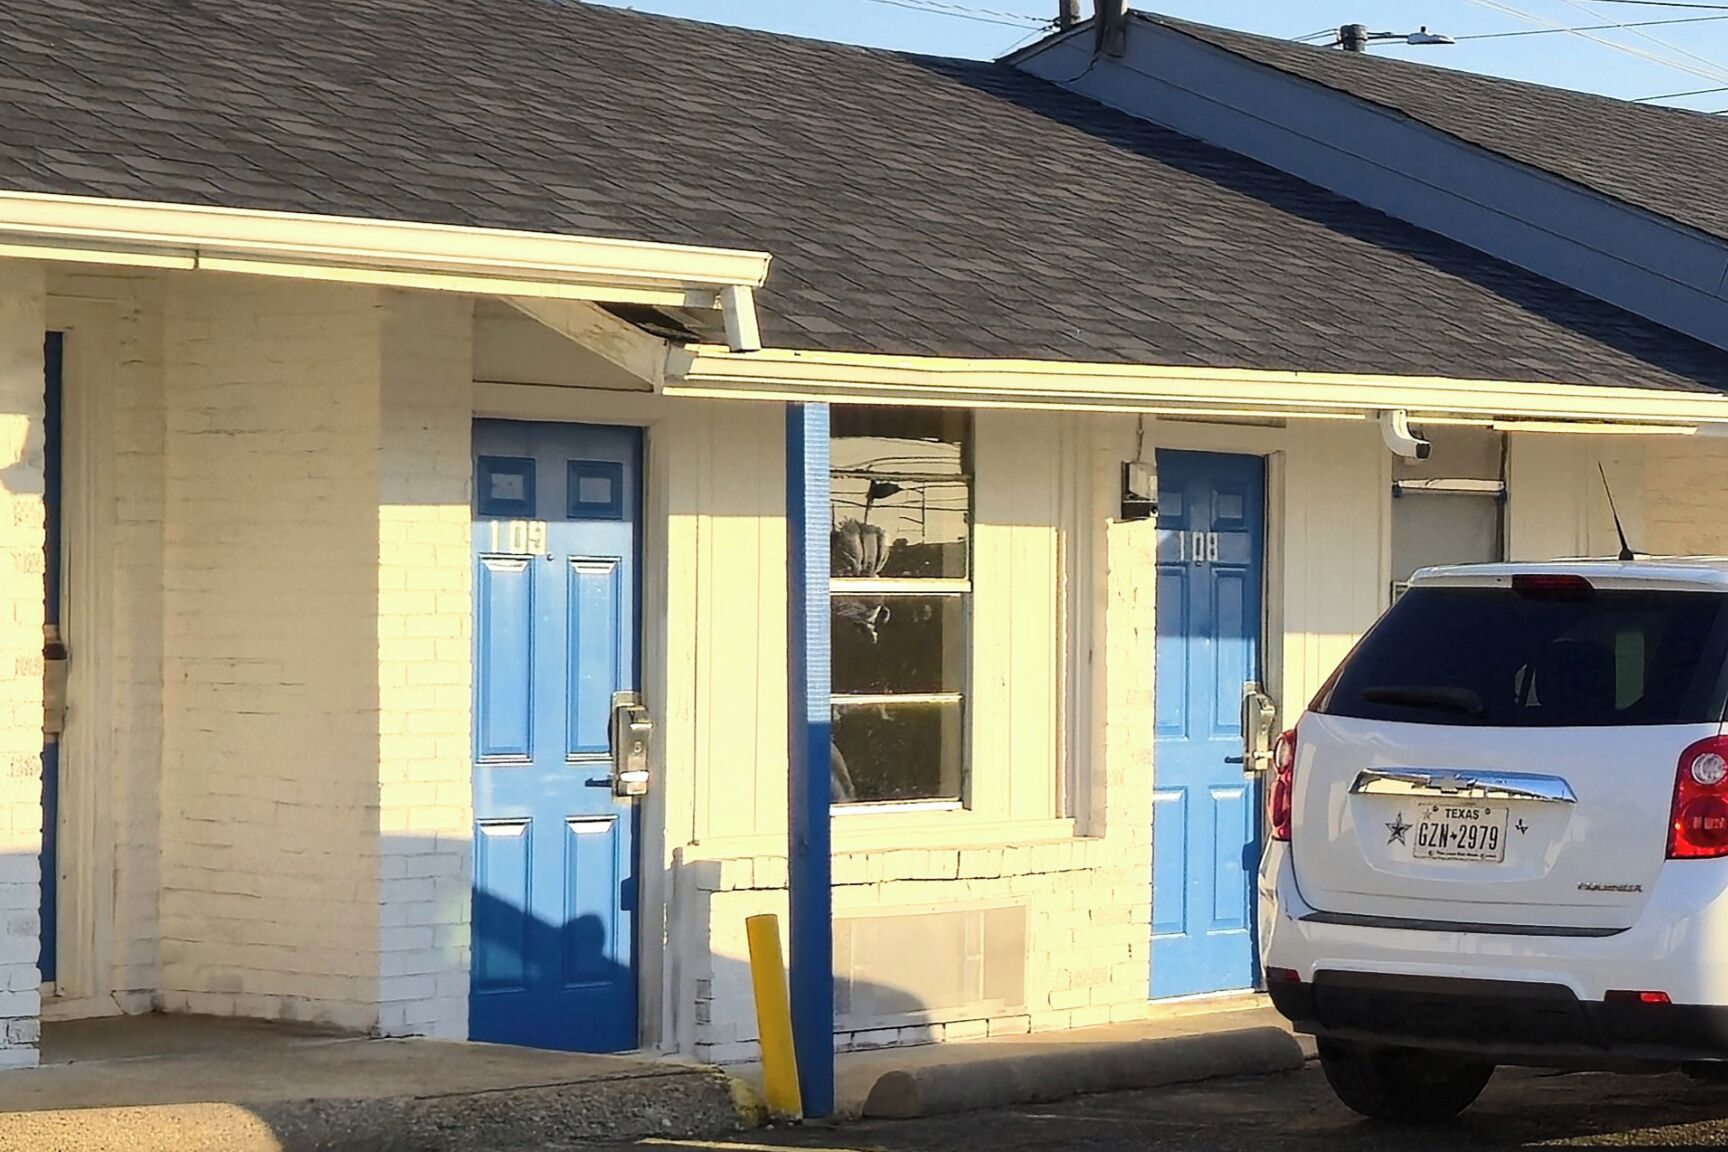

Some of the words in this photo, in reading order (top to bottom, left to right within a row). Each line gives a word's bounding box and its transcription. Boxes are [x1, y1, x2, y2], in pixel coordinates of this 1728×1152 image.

[490, 520, 546, 555] 109
[1180, 530, 1218, 561] 108
[1445, 808, 1480, 820] TEXAS
